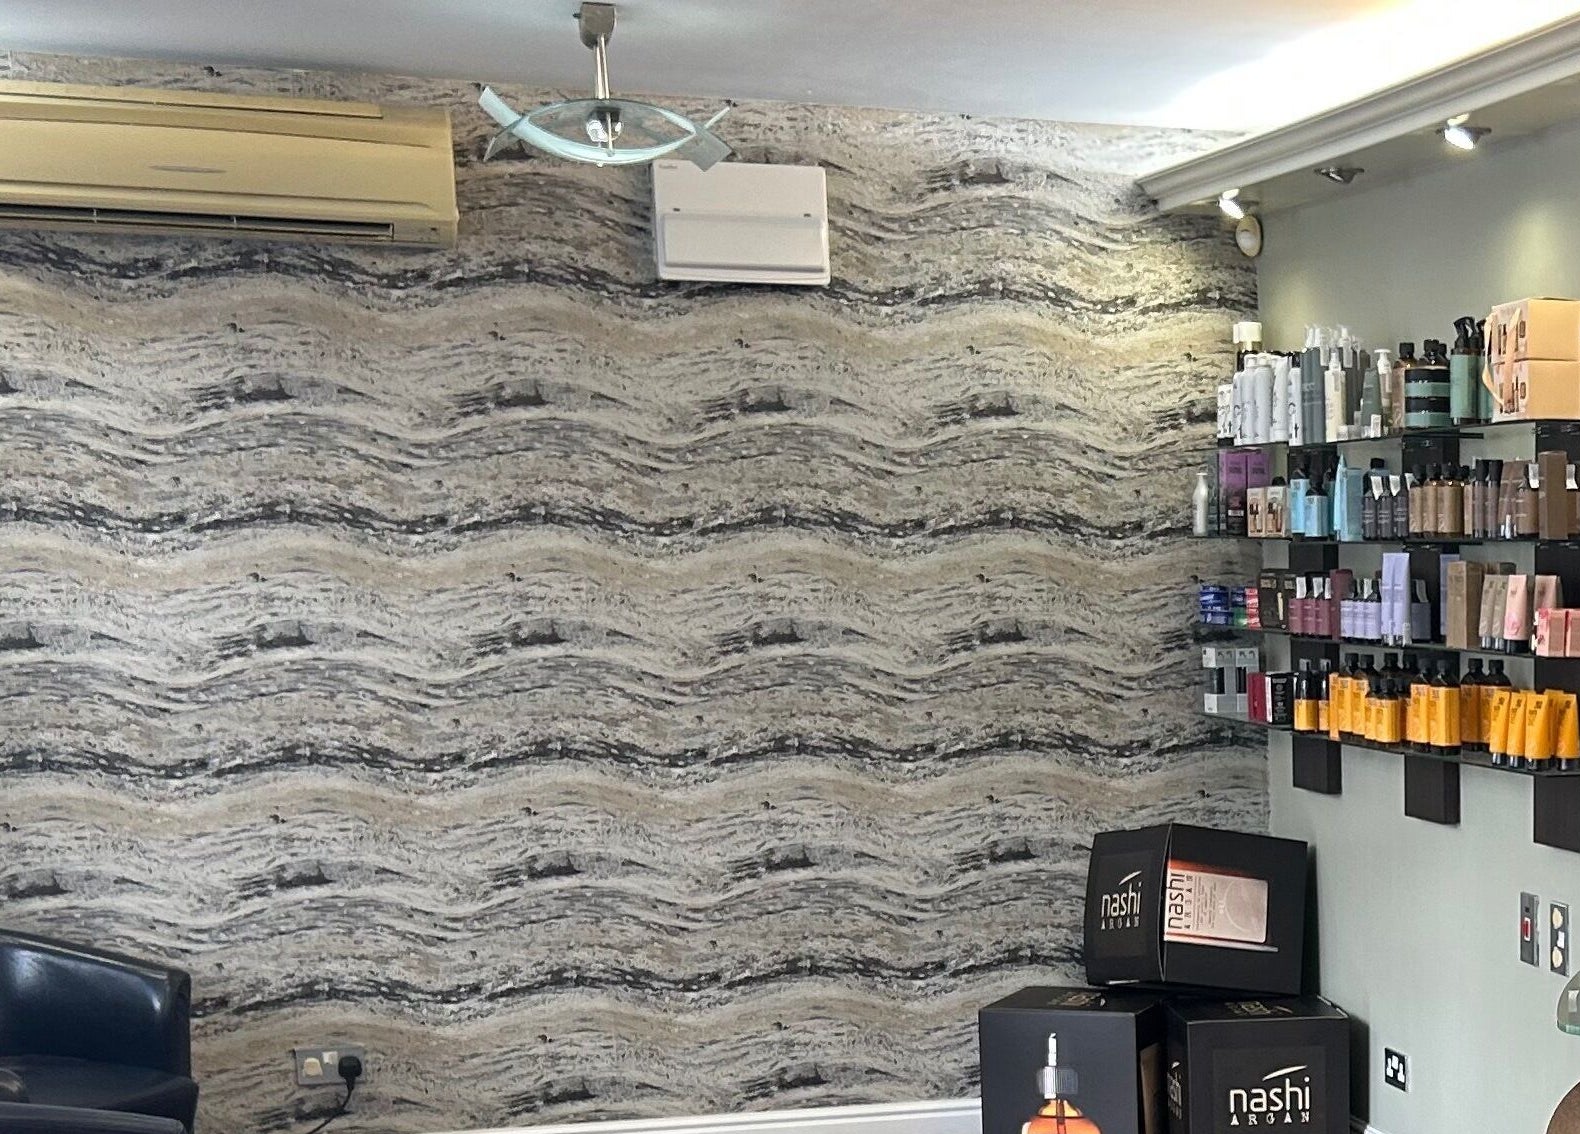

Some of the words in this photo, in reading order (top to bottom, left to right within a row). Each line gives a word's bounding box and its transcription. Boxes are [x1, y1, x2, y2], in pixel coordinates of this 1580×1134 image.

[1101, 882, 1142, 918] nashi
[1168, 873, 1186, 930] nashi
[1101, 915, 1140, 930] ARGAN
[1229, 1076, 1310, 1113] nashi
[1230, 1111, 1310, 1126] ARGAN
